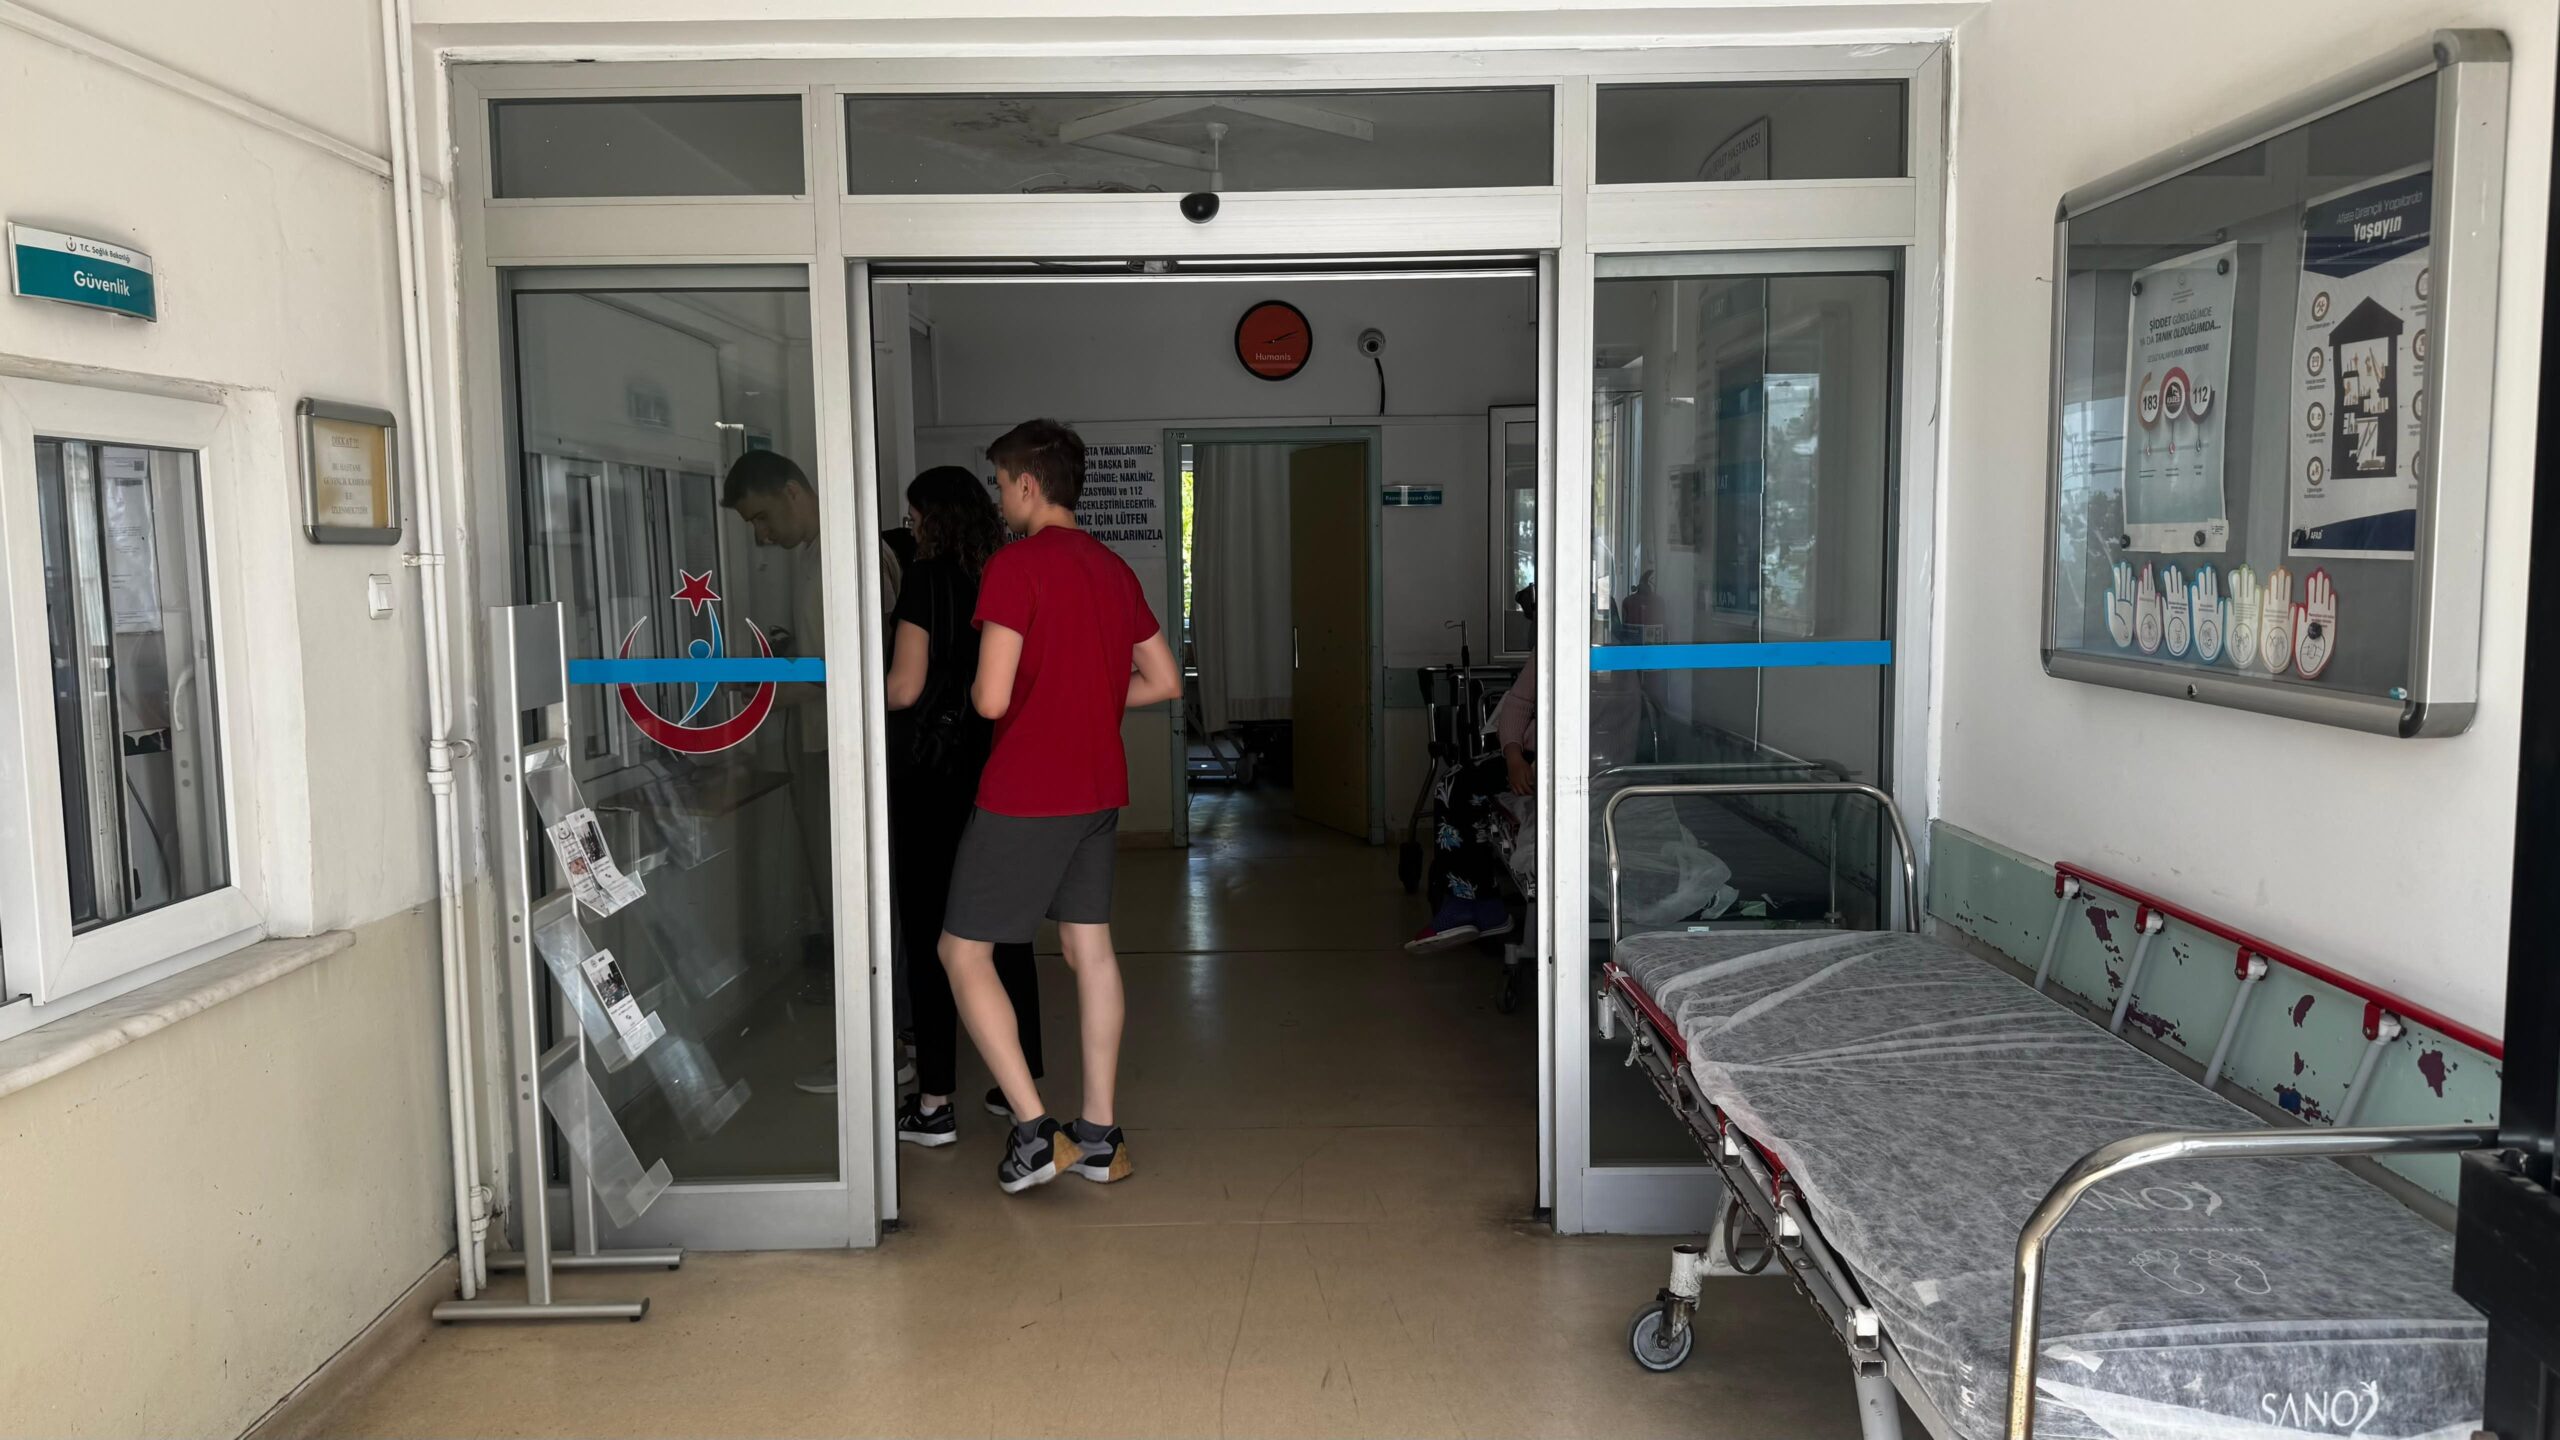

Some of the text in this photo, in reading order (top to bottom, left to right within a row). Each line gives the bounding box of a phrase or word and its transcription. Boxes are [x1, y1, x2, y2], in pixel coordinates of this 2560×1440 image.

[2353, 215, 2402, 243] Yaşayın
[80, 243, 90, 252] T.C.
[92, 246, 109, 256] Sağlık
[73, 270, 131, 297] Güvenlik
[2149, 315, 2172, 333] ŞİDDET
[2155, 329, 2173, 344] TANIK
[2192, 386, 2208, 404] 112
[2143, 395, 2158, 411] 183
[1085, 445, 1153, 456] STA YAKINLARIMIZ:
[1084, 457, 1136, 470] ÇİN BAŞKA BİR
[1118, 488, 1127, 496] ve
[1129, 486, 1143, 496] 112
[1076, 497, 1157, 510] RÇEKLEŞTİRİLECEKTİR.
[1095, 511, 1113, 526] İÇİN
[1115, 511, 1148, 525] LÜTFEN
[2261, 1389, 2359, 1428] SANO
